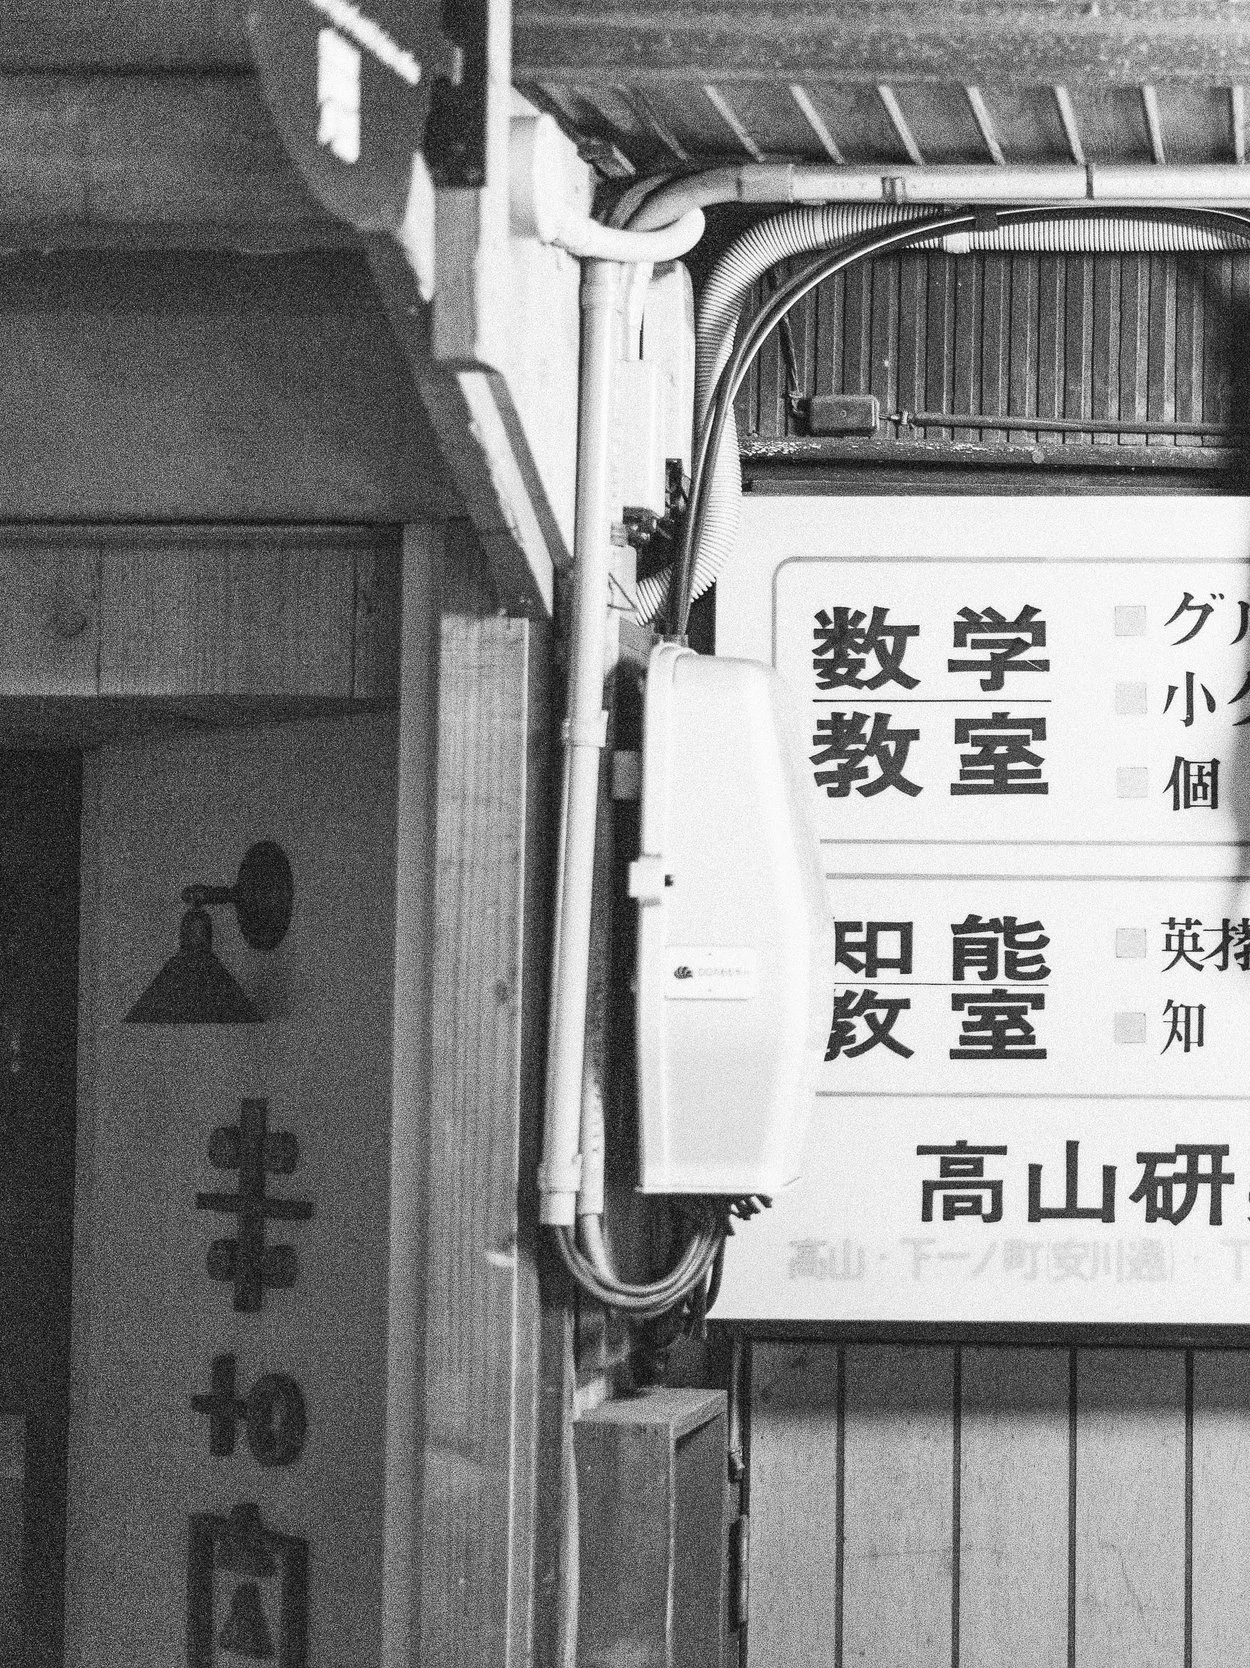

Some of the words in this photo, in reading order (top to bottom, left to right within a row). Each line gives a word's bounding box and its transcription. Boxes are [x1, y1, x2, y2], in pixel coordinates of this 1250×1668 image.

[811, 604, 1050, 692] 数学
[809, 711, 1049, 798] 教室
[833, 913, 1052, 981] 知能
[824, 988, 1048, 1061] 教室
